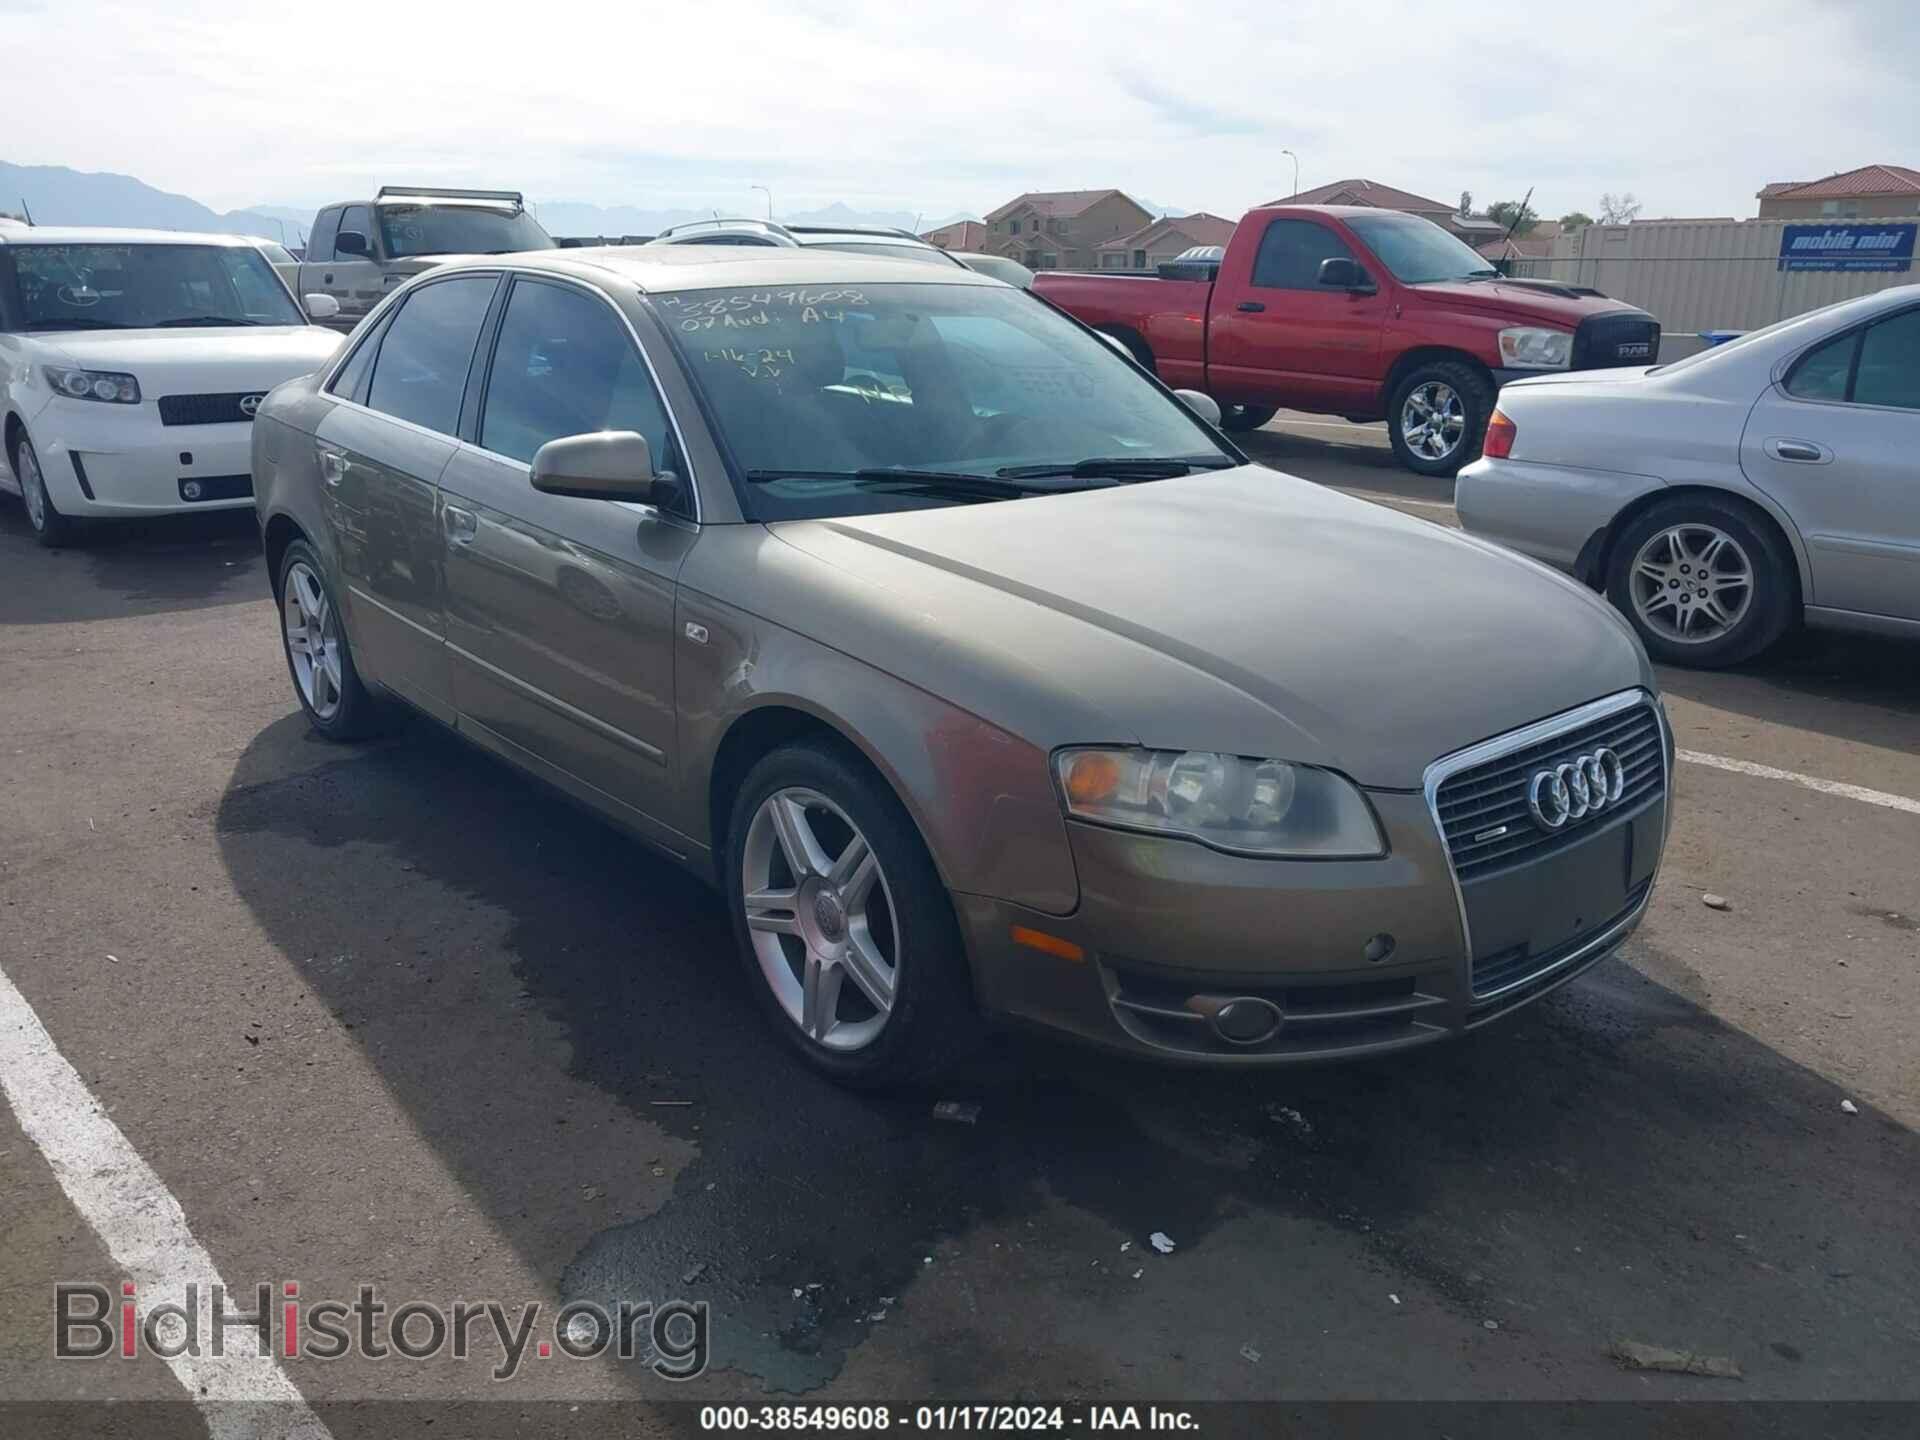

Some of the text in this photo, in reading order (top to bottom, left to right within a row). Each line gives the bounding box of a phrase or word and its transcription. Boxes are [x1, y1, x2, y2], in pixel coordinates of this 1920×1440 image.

[1791, 230, 1905, 249] mobile mini
[679, 289, 870, 319] 38549608
[802, 307, 845, 323] A4
